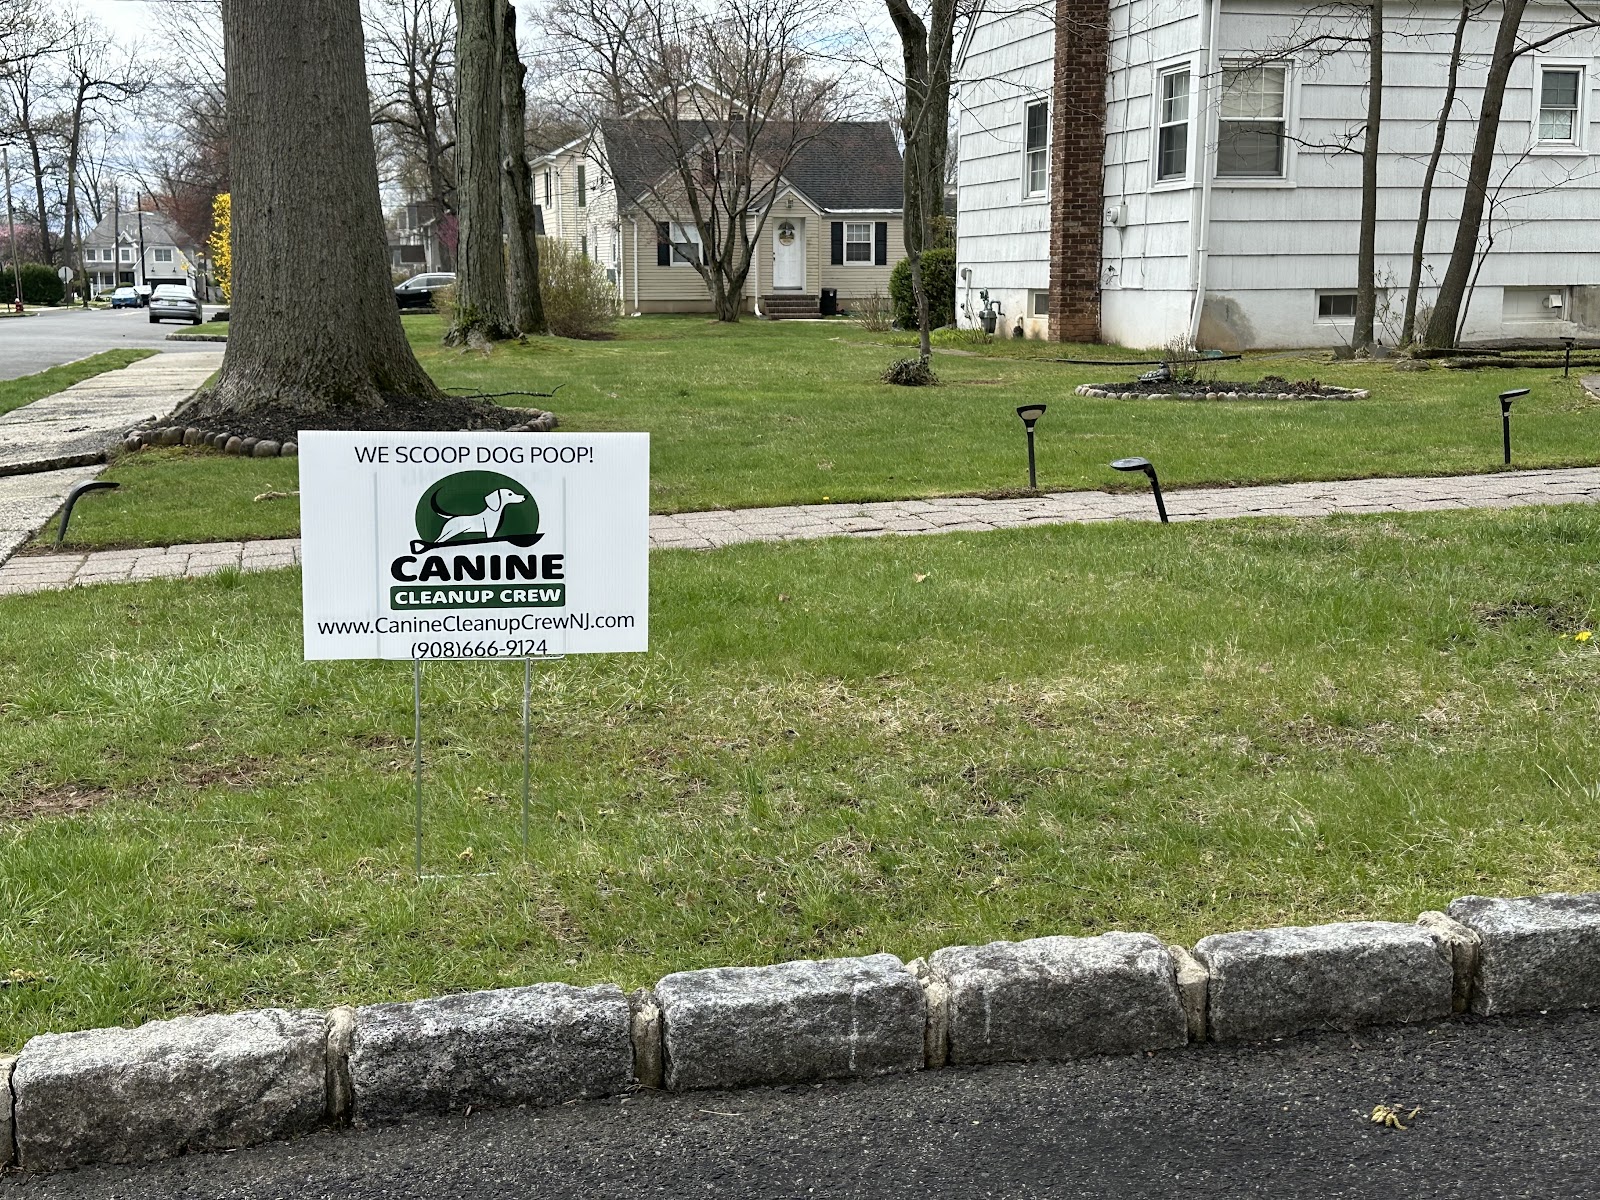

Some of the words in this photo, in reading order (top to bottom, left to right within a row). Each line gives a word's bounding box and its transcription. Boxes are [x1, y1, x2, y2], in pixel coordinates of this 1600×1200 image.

[355, 446, 389, 464] WE
[396, 446, 471, 464] SCOOP
[477, 446, 524, 464] DOG
[530, 446, 594, 464] POOP!
[391, 554, 564, 582] CANINE
[394, 590, 494, 605] CLEANUP
[500, 588, 562, 603] CREW
[317, 613, 635, 635] www.CanineCleanupCrewNJ.com
[411, 639, 548, 659] (908)666-9124
